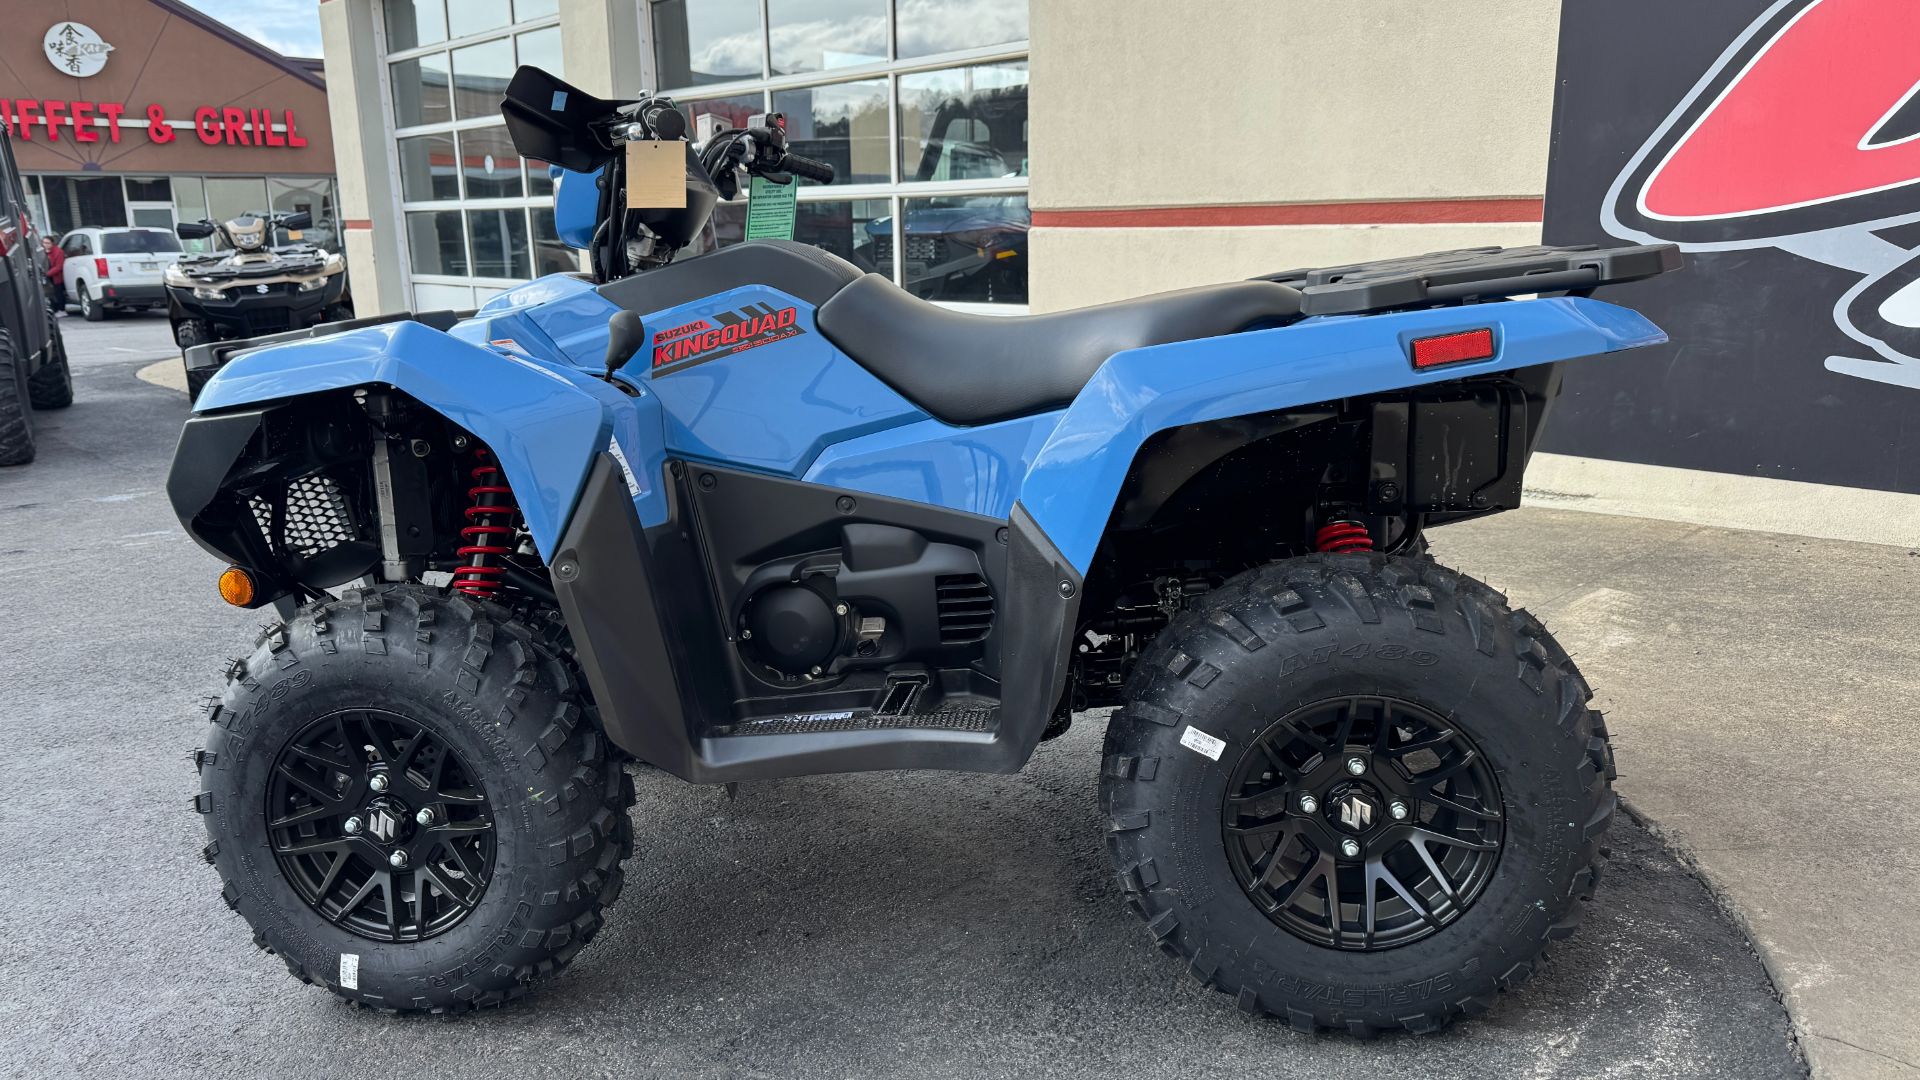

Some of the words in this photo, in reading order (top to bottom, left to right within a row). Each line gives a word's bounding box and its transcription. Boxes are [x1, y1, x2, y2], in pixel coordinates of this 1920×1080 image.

[146, 103, 177, 144] &
[195, 106, 307, 147] GRILL
[653, 307, 797, 367] KINGQUAD
[655, 321, 704, 343] SUZUKI
